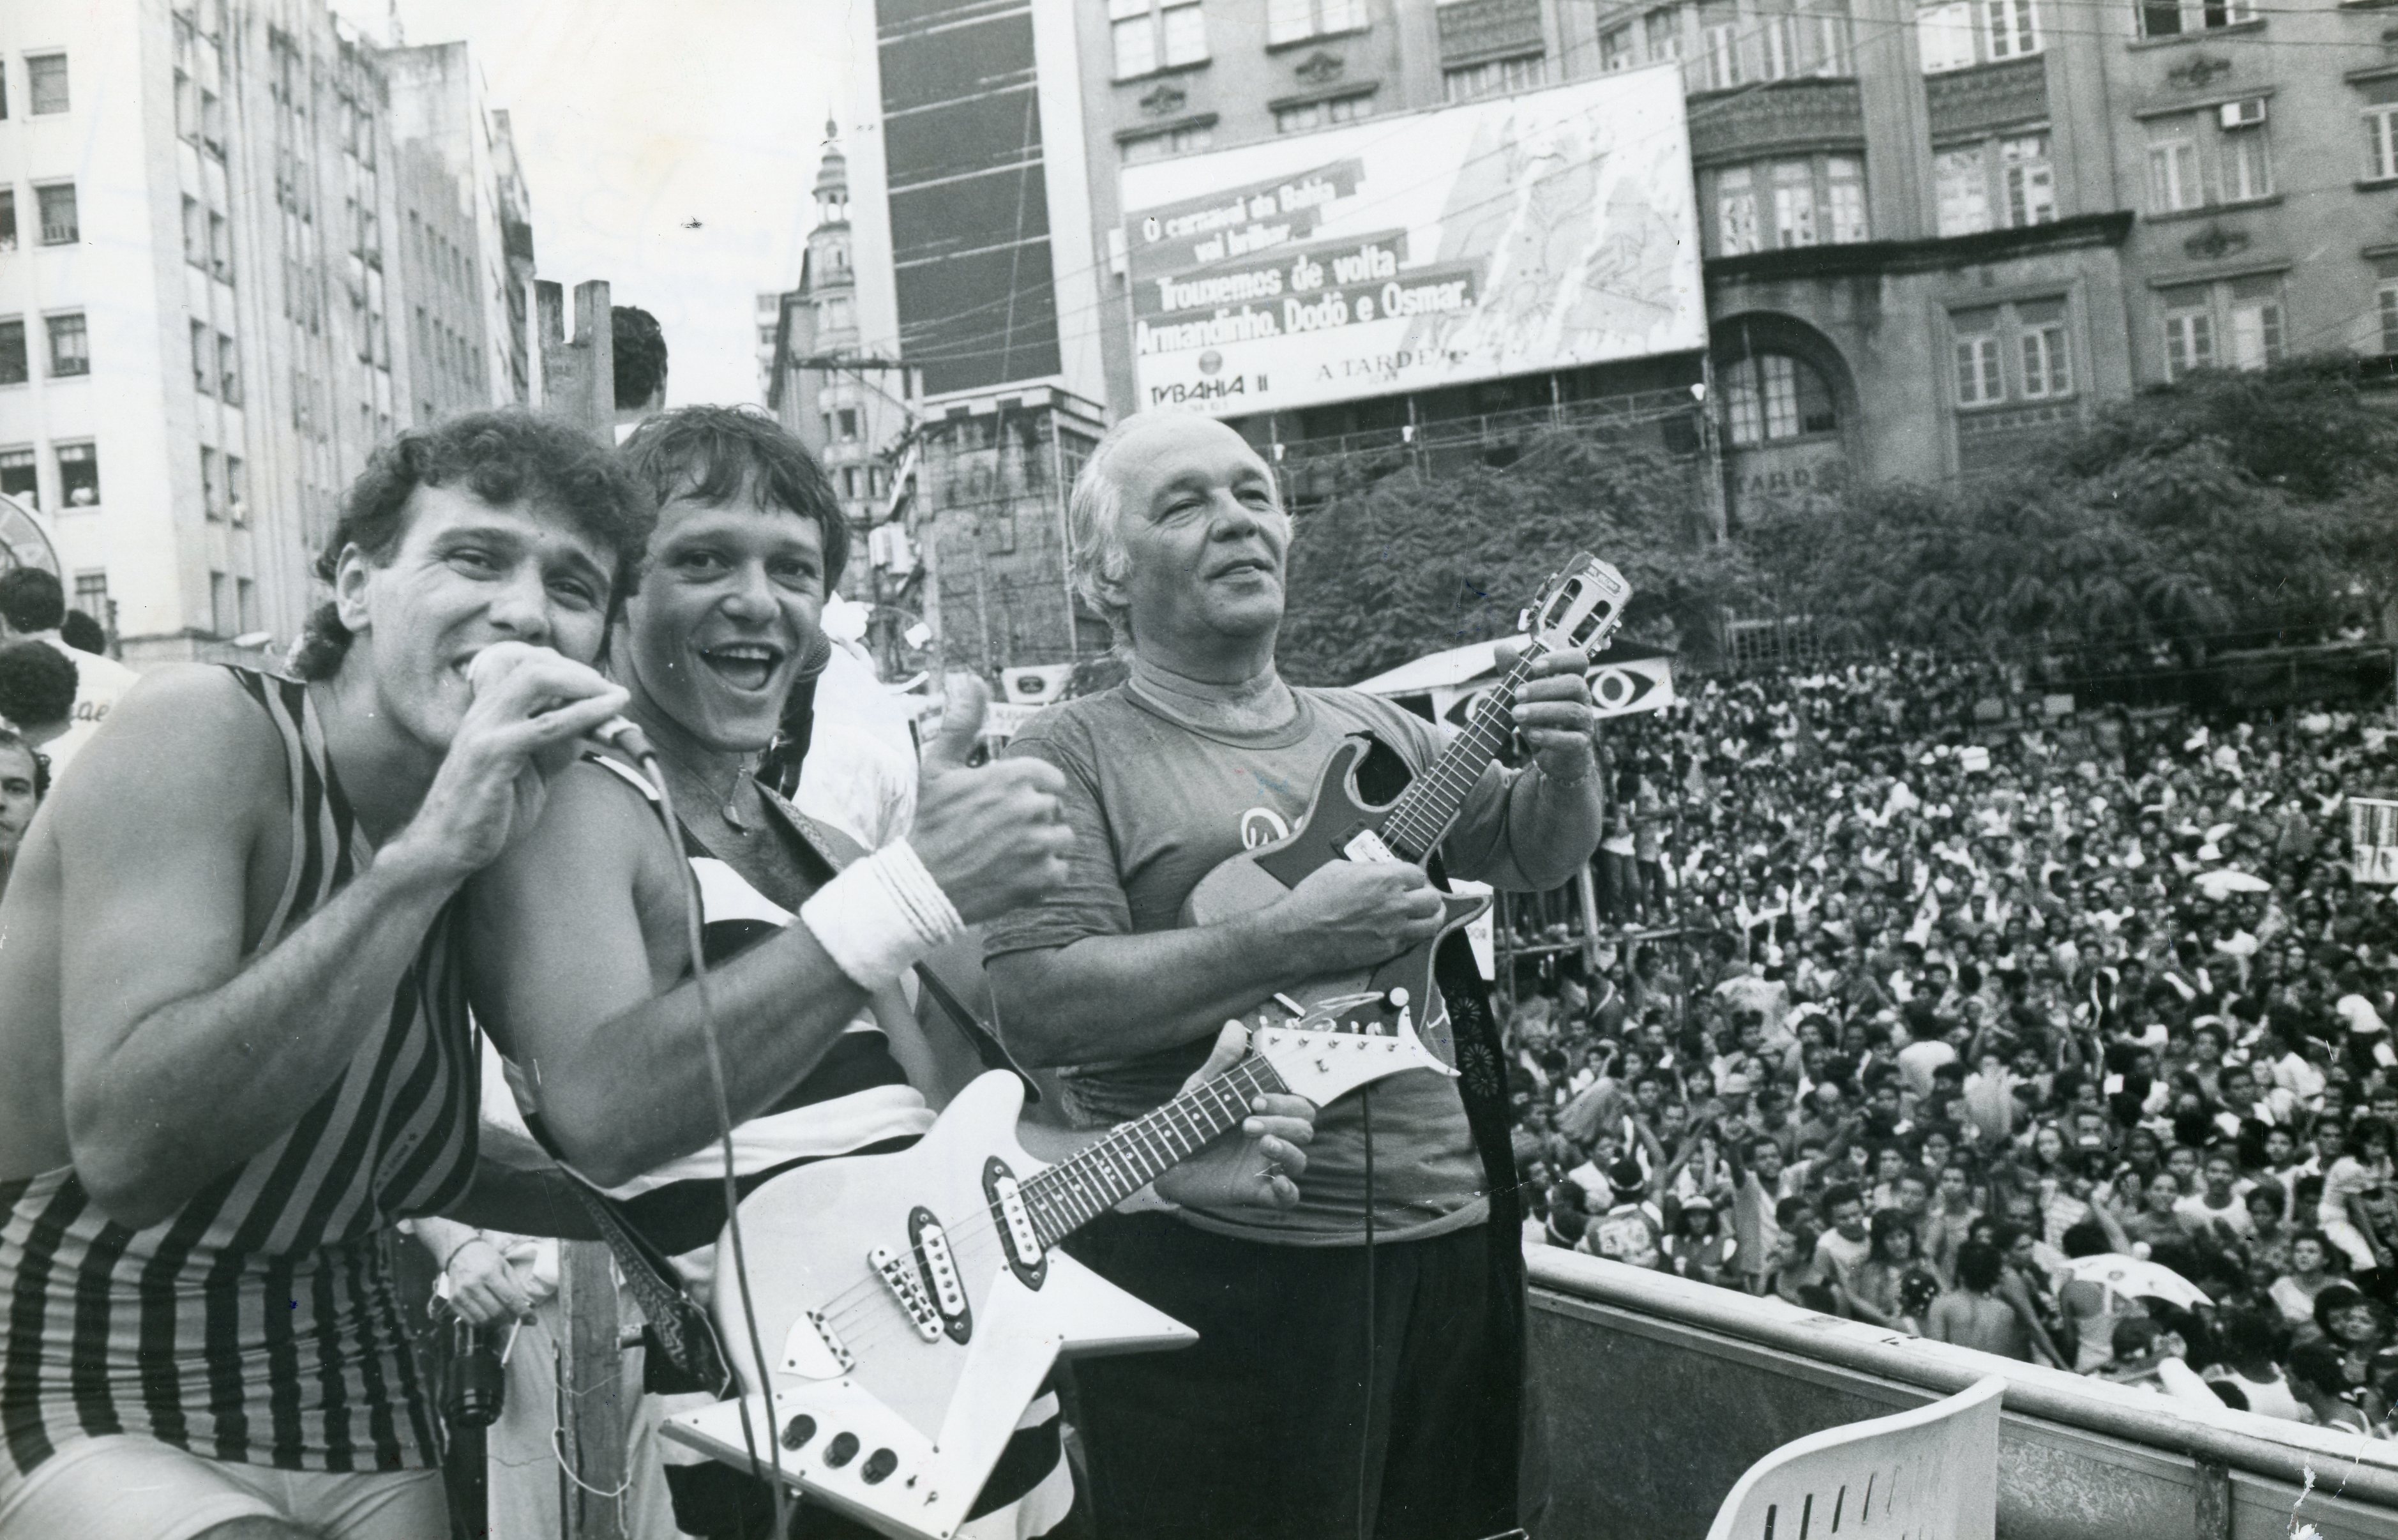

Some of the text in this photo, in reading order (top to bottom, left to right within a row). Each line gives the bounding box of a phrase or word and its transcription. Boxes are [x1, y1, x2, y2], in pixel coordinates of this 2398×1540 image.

[1143, 217, 1161, 243] O
[1278, 176, 1336, 213] Bahia
[1156, 245, 1397, 312] Trouxemos de volta
[1283, 291, 1348, 335] Dodô
[1356, 296, 1374, 321] e
[1382, 280, 1473, 319] Osmar.
[1316, 364, 1334, 381] A
